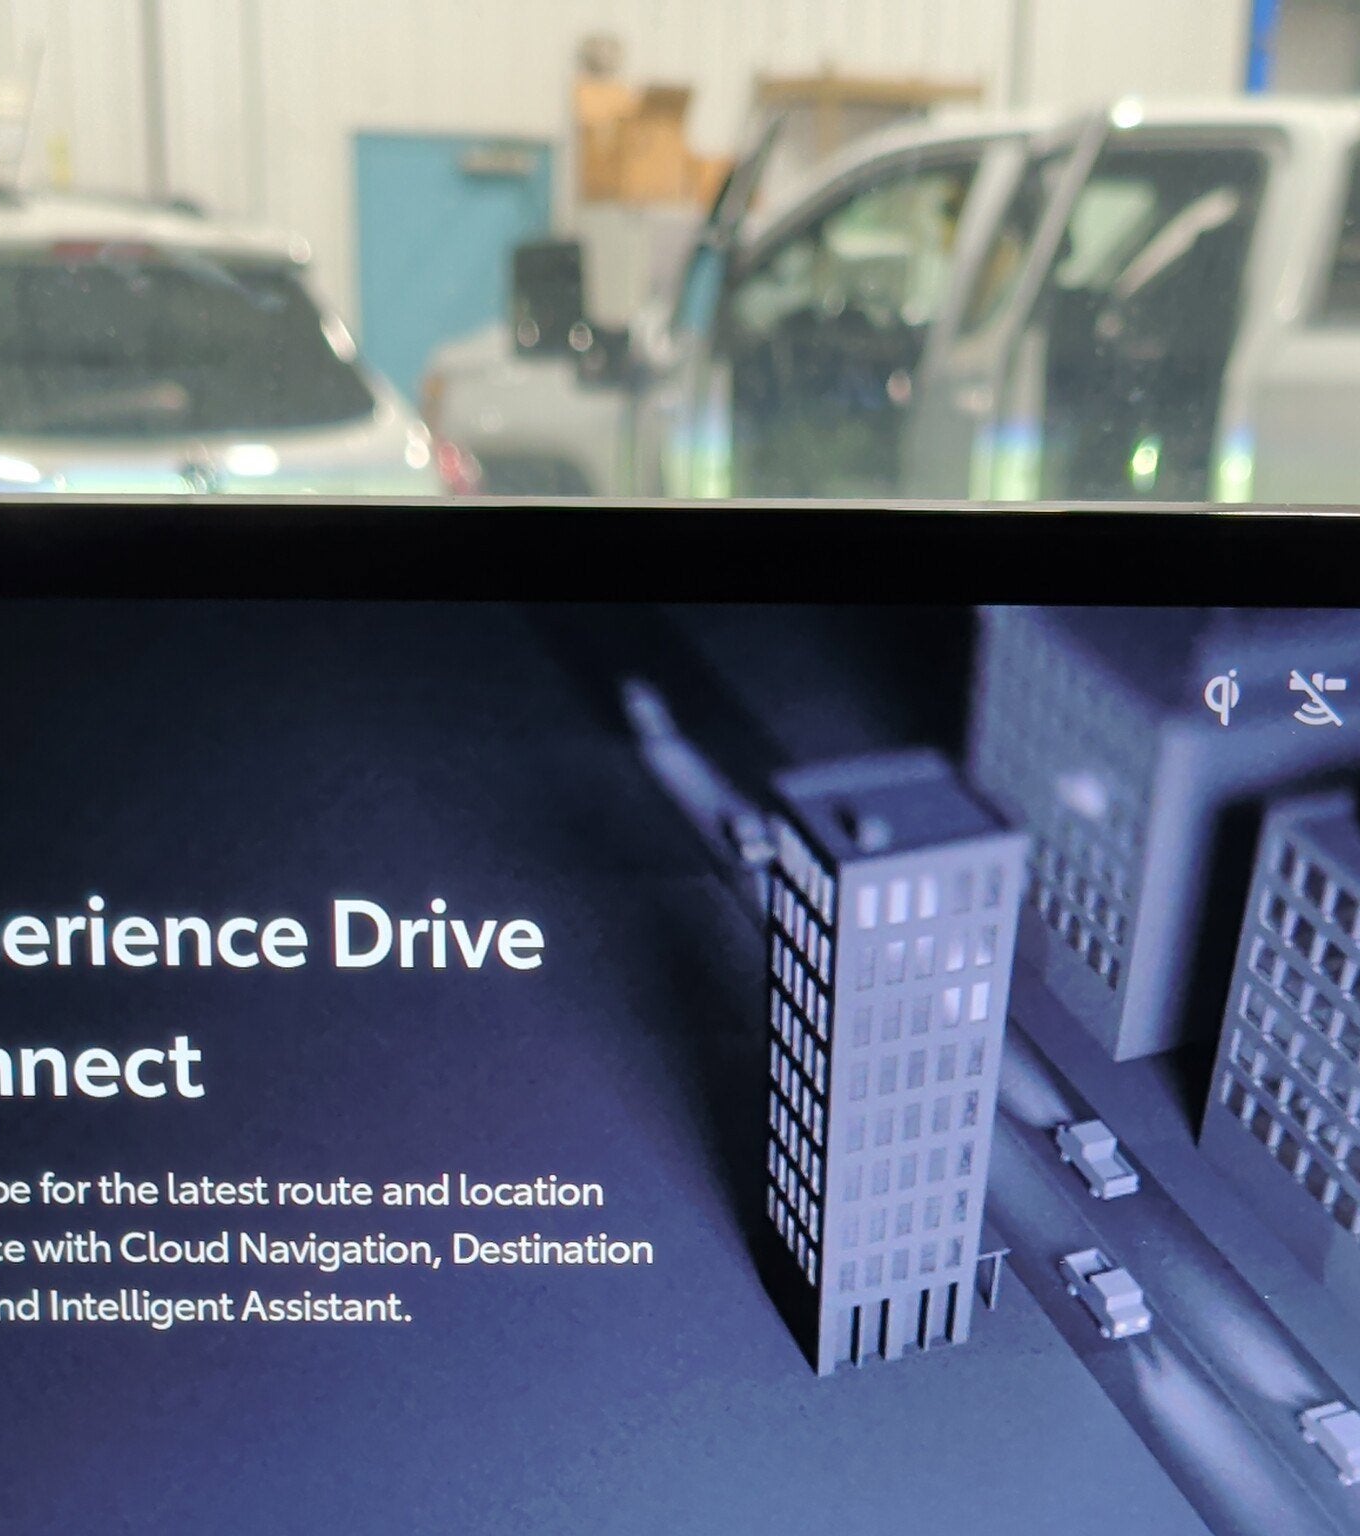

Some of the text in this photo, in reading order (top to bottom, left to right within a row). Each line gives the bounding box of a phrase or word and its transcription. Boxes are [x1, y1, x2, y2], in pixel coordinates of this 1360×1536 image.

[333, 897, 546, 970] Drive
[40, 1171, 91, 1206] for
[99, 1172, 158, 1206] the
[168, 1173, 269, 1206] latest
[278, 1178, 373, 1207] route
[382, 1174, 449, 1207] and
[459, 1174, 604, 1208] location
[33, 1231, 111, 1264] with
[119, 1231, 229, 1265] Cloud
[240, 1232, 443, 1272] Navigation,
[453, 1232, 654, 1266] Destination
[49, 1290, 234, 1330] Intelligent
[241, 1290, 413, 1323] Assistant.
